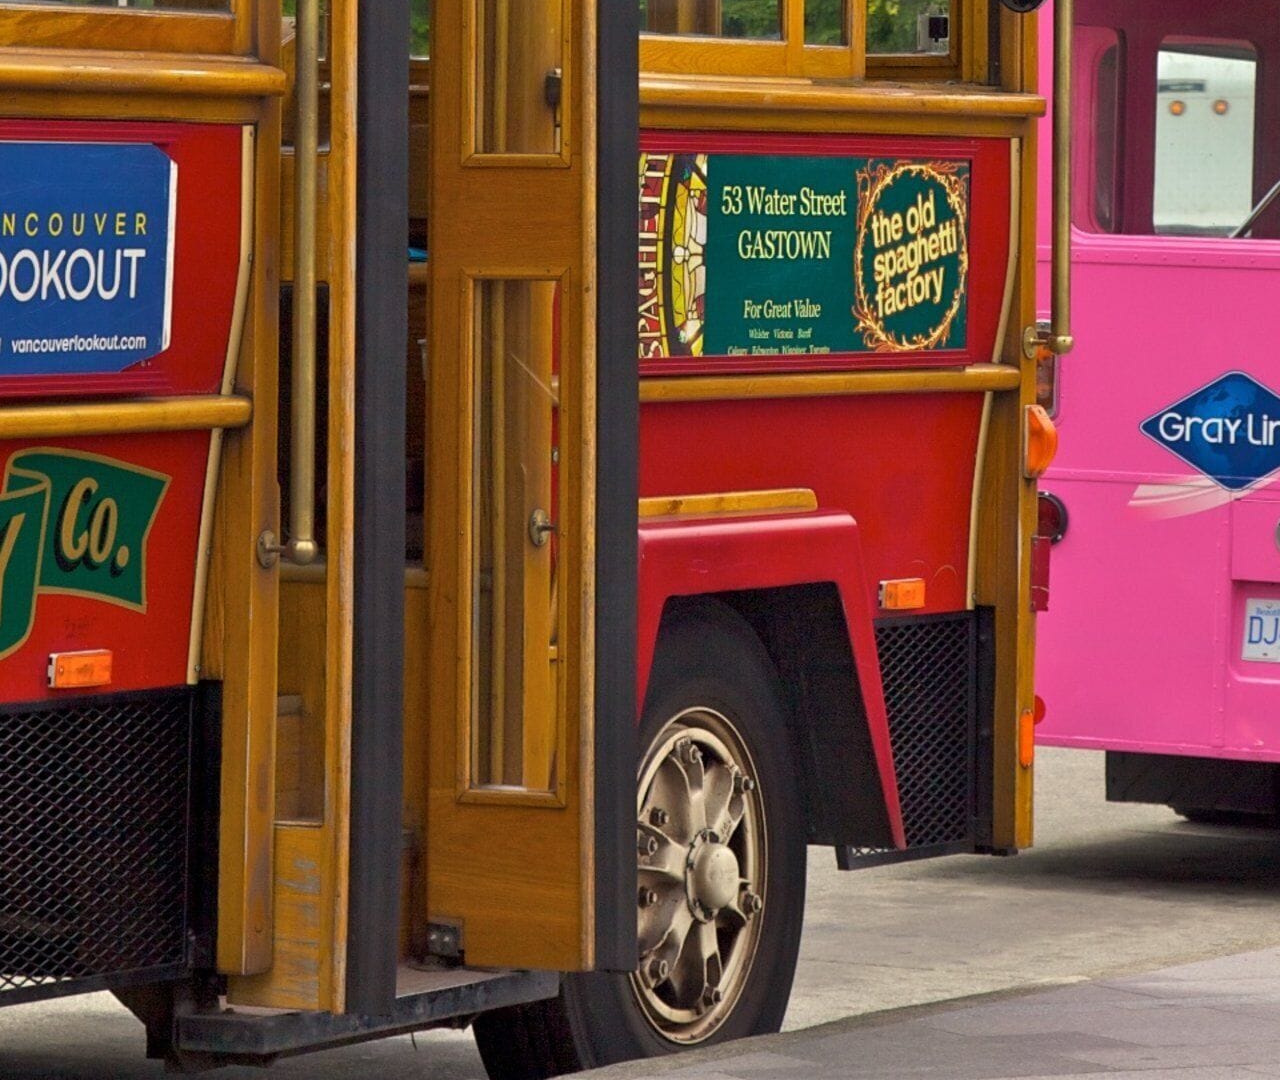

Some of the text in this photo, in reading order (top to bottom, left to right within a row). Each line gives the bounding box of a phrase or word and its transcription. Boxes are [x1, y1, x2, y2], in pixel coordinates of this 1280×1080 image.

[721, 186, 847, 216] 53 Water Street
[872, 189, 935, 248] the old
[738, 230, 831, 259] GASTOWN
[874, 220, 957, 285] spaghetti
[875, 267, 944, 318] factory
[744, 298, 821, 319] For Great Value
[11, 334, 147, 353] vancouverlookout.com
[1159, 412, 1241, 444] Gray
[1248, 616, 1279, 645] DJ
